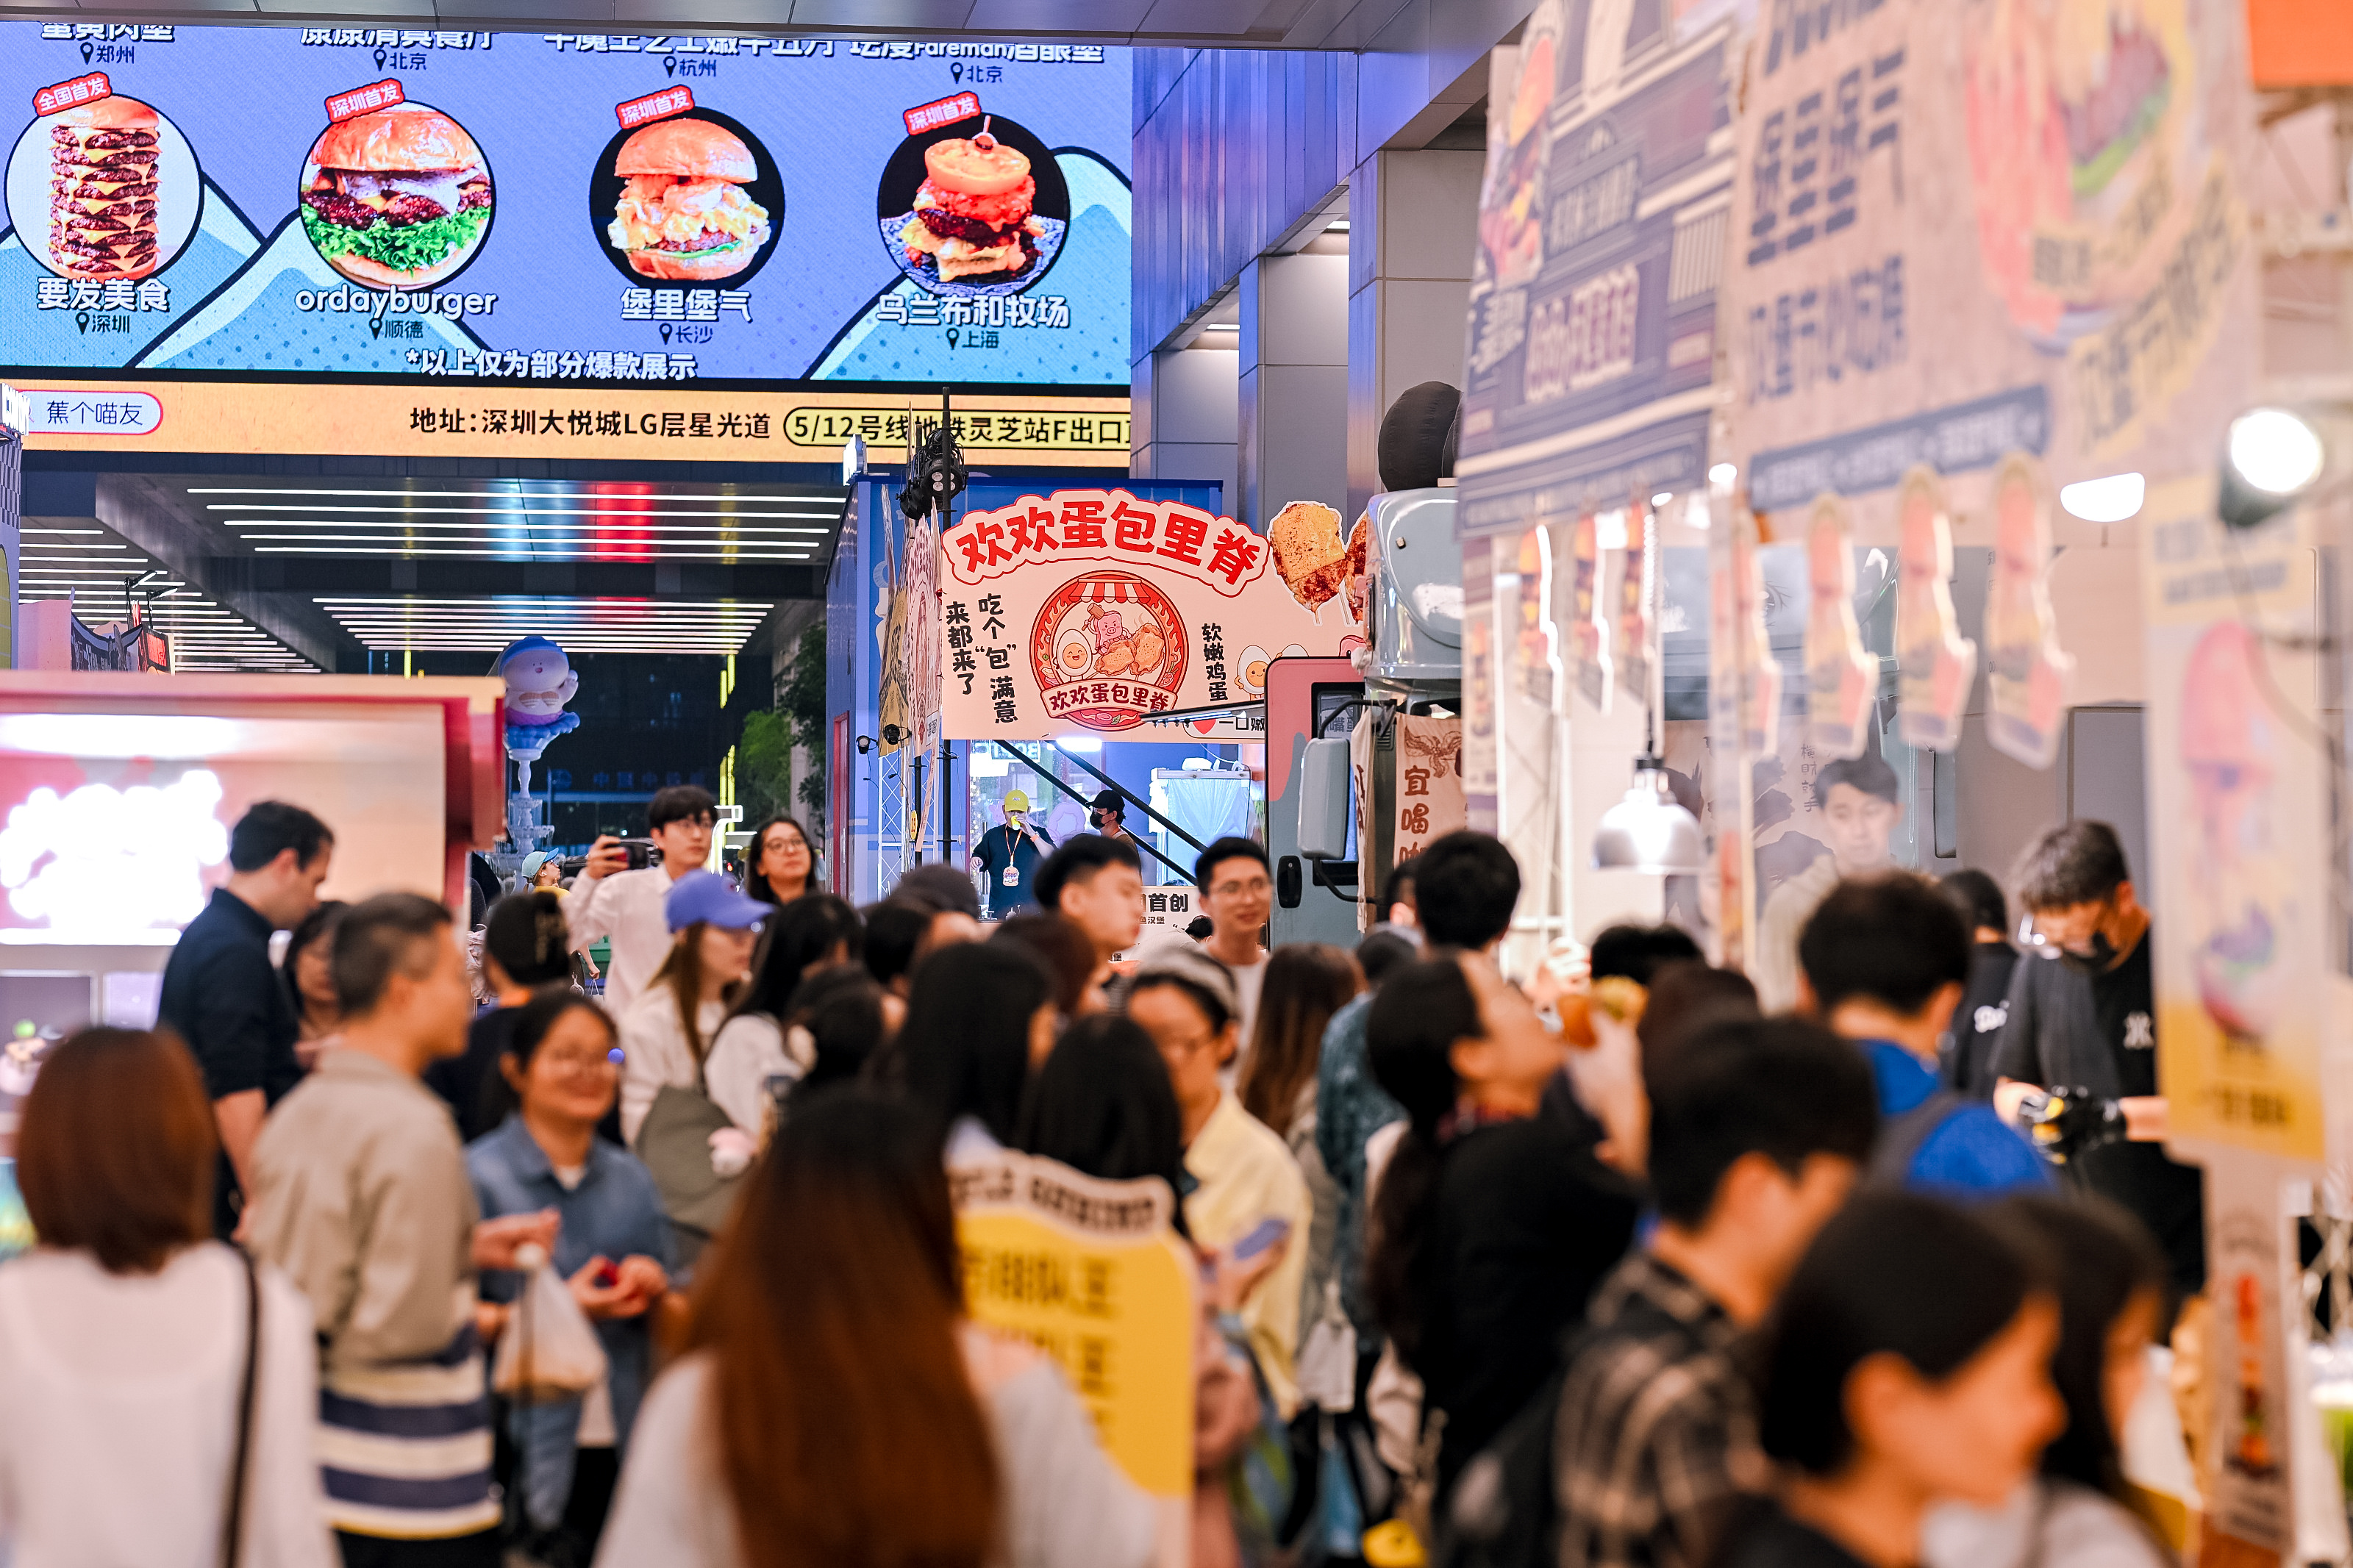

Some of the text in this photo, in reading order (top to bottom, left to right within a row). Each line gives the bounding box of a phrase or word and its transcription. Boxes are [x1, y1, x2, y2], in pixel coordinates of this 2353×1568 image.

[96, 45, 135, 64] 郑州
[389, 52, 426, 71] 北京
[679, 59, 717, 77] 杭州
[967, 65, 1003, 83] 北京
[38, 77, 107, 112] 全国首发
[330, 83, 401, 118] 深圳首发
[620, 90, 690, 123] 深圳首发
[907, 96, 977, 131] 深圳首发
[37, 277, 170, 312] 要发美食
[294, 283, 499, 321] ordayburger
[621, 287, 753, 323] 堡里堡气
[91, 315, 130, 334] 深圳
[876, 293, 1070, 328] 乌兰布和牧场
[384, 320, 424, 339] 顺德
[676, 325, 713, 344] 长沙
[962, 331, 999, 348] 上海
[47, 400, 143, 426] 蕉个喵友
[410, 408, 771, 438] 地址：深圳大悦城LG层星光道
[794, 415, 1130, 444] 5/12号线地铁灵芝站F出口
[956, 501, 1260, 585] 欢欢蛋包里脊
[946, 601, 976, 695] 来都来了
[1201, 623, 1228, 701] 软嫩鸡蛋
[1049, 683, 1169, 710] 欢欢蛋包里脊
